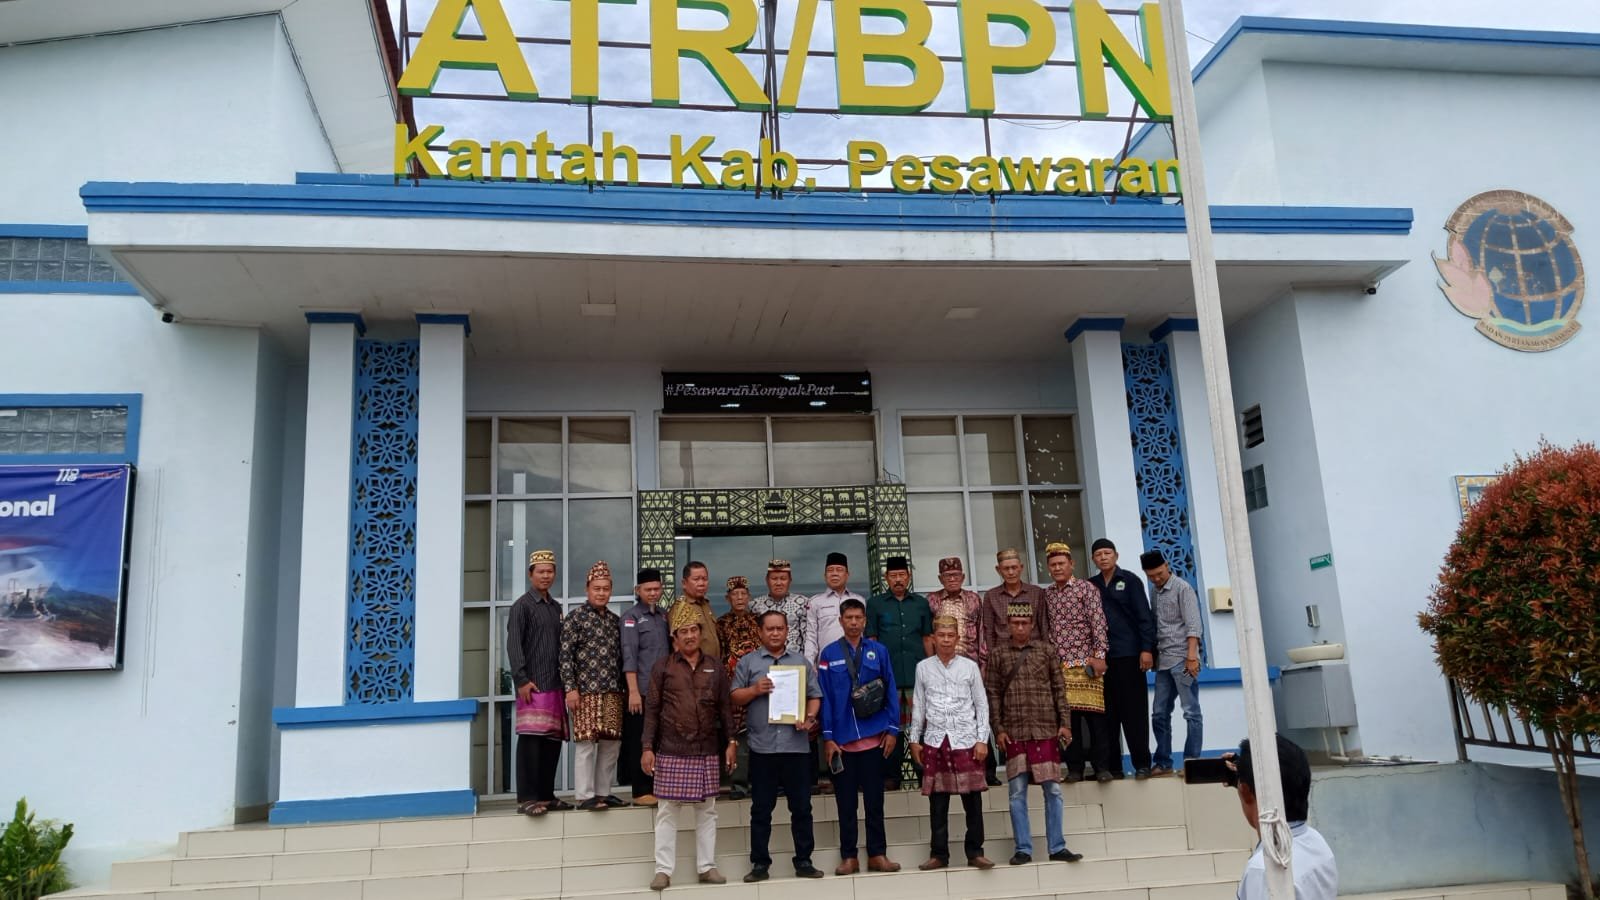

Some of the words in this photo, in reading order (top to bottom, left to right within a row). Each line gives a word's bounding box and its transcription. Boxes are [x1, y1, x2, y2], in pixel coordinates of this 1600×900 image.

[397, 0, 1173, 120] ATR/BPN
[394, 123, 639, 187] Kantah
[670, 134, 816, 191] Kab.
[847, 140, 1181, 196] Pesawaran
